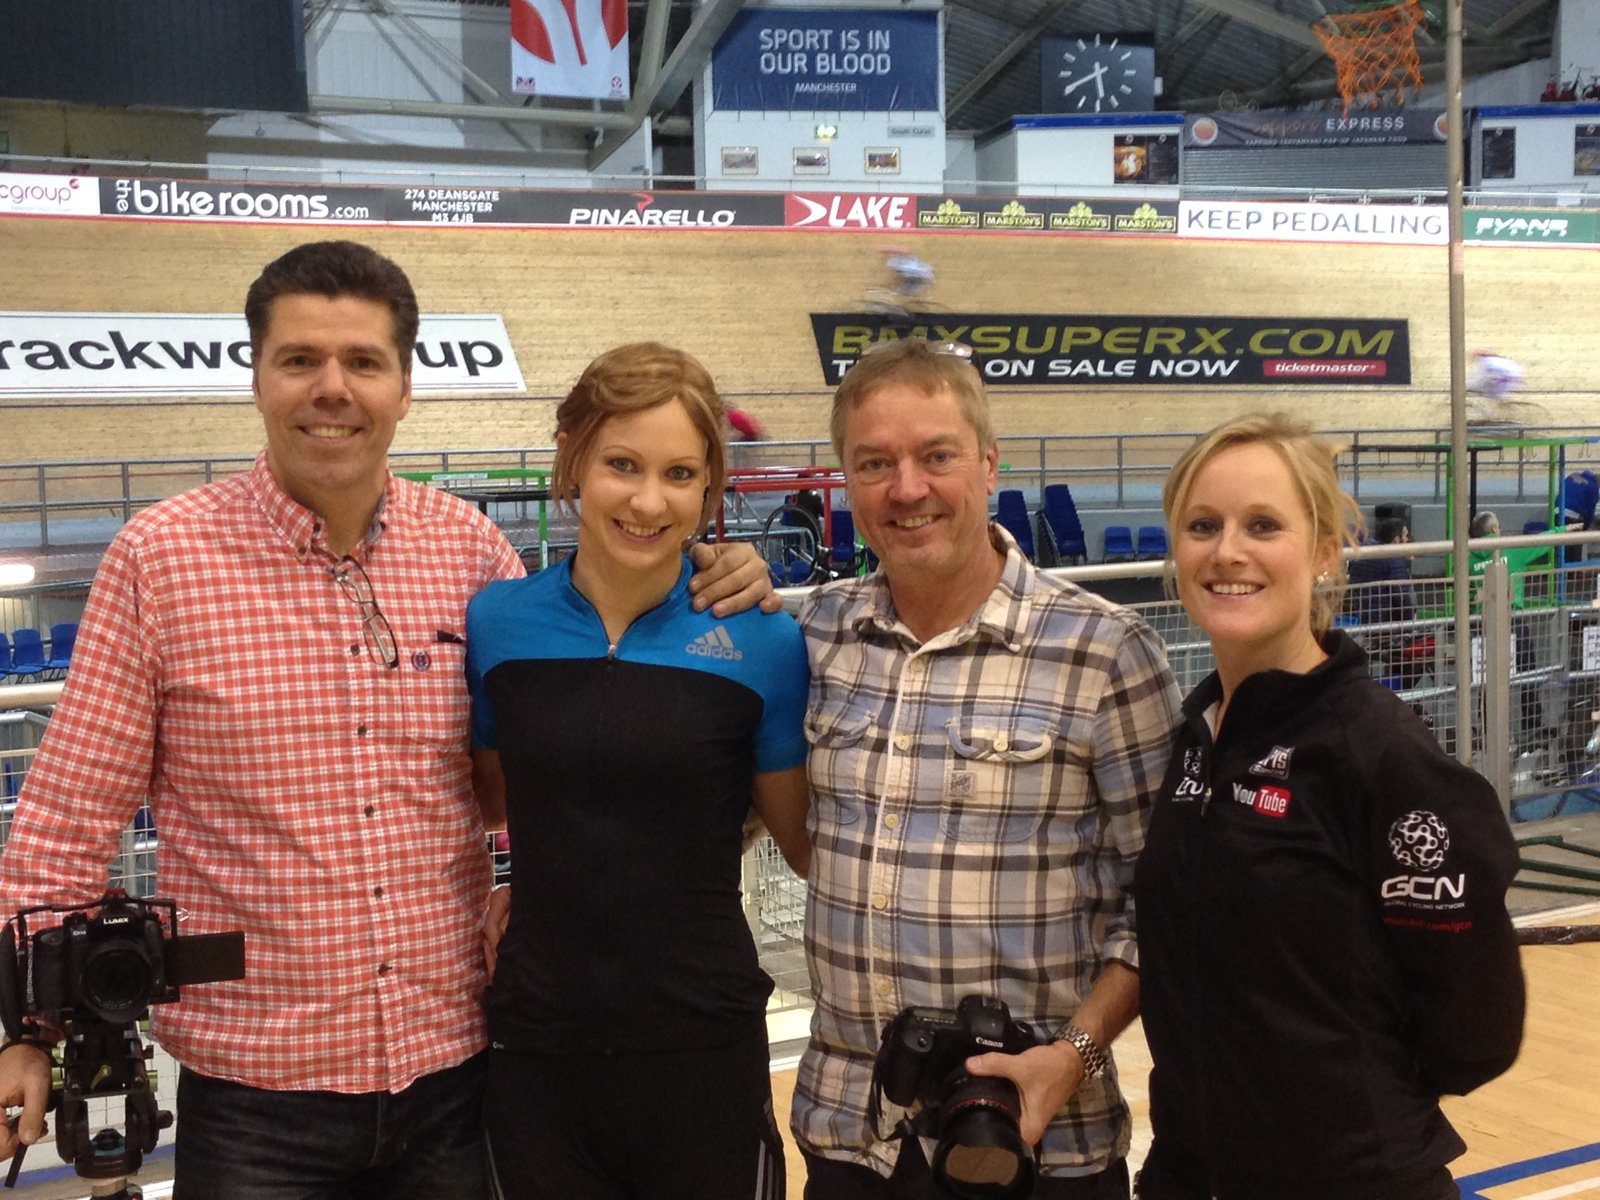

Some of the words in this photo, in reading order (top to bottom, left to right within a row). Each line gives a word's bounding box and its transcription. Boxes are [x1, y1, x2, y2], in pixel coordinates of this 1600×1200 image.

[759, 28, 833, 50] SPORT
[840, 29, 861, 51] IS
[867, 30, 891, 51] IN
[760, 52, 808, 74] OUR
[815, 53, 891, 75] BLOOD
[795, 82, 857, 93] MANCHESTER
[1325, 116, 1405, 131] EXPRESS
[115, 179, 131, 213] the
[405, 188, 425, 200] 274
[428, 189, 500, 202] DEANSGATE
[411, 201, 493, 213] MANCHESTER
[827, 195, 909, 228] LAKE
[431, 213, 449, 223] M3
[451, 213, 475, 223] 4JB
[568, 208, 735, 227] PINARELLO
[922, 215, 976, 226] MARSTON'S
[986, 216, 1041, 227] MARSTON'S
[1053, 217, 1107, 229] MARSTON'S
[1187, 208, 1263, 230] KEEP
[1272, 211, 1442, 235] PEDALLING
[1118, 219, 1173, 230] MARSTON'S
[984, 359, 1035, 378] ON
[1047, 360, 1137, 379] SALE
[1148, 360, 1240, 378] NOW
[1275, 362, 1370, 374] ticketmaster
[685, 643, 743, 660] adidas
[1381, 873, 1465, 901] GCN
[1434, 902, 1465, 911] NETWORK
[103, 917, 129, 925] LUMIX
[975, 1036, 1004, 1048] Canon
